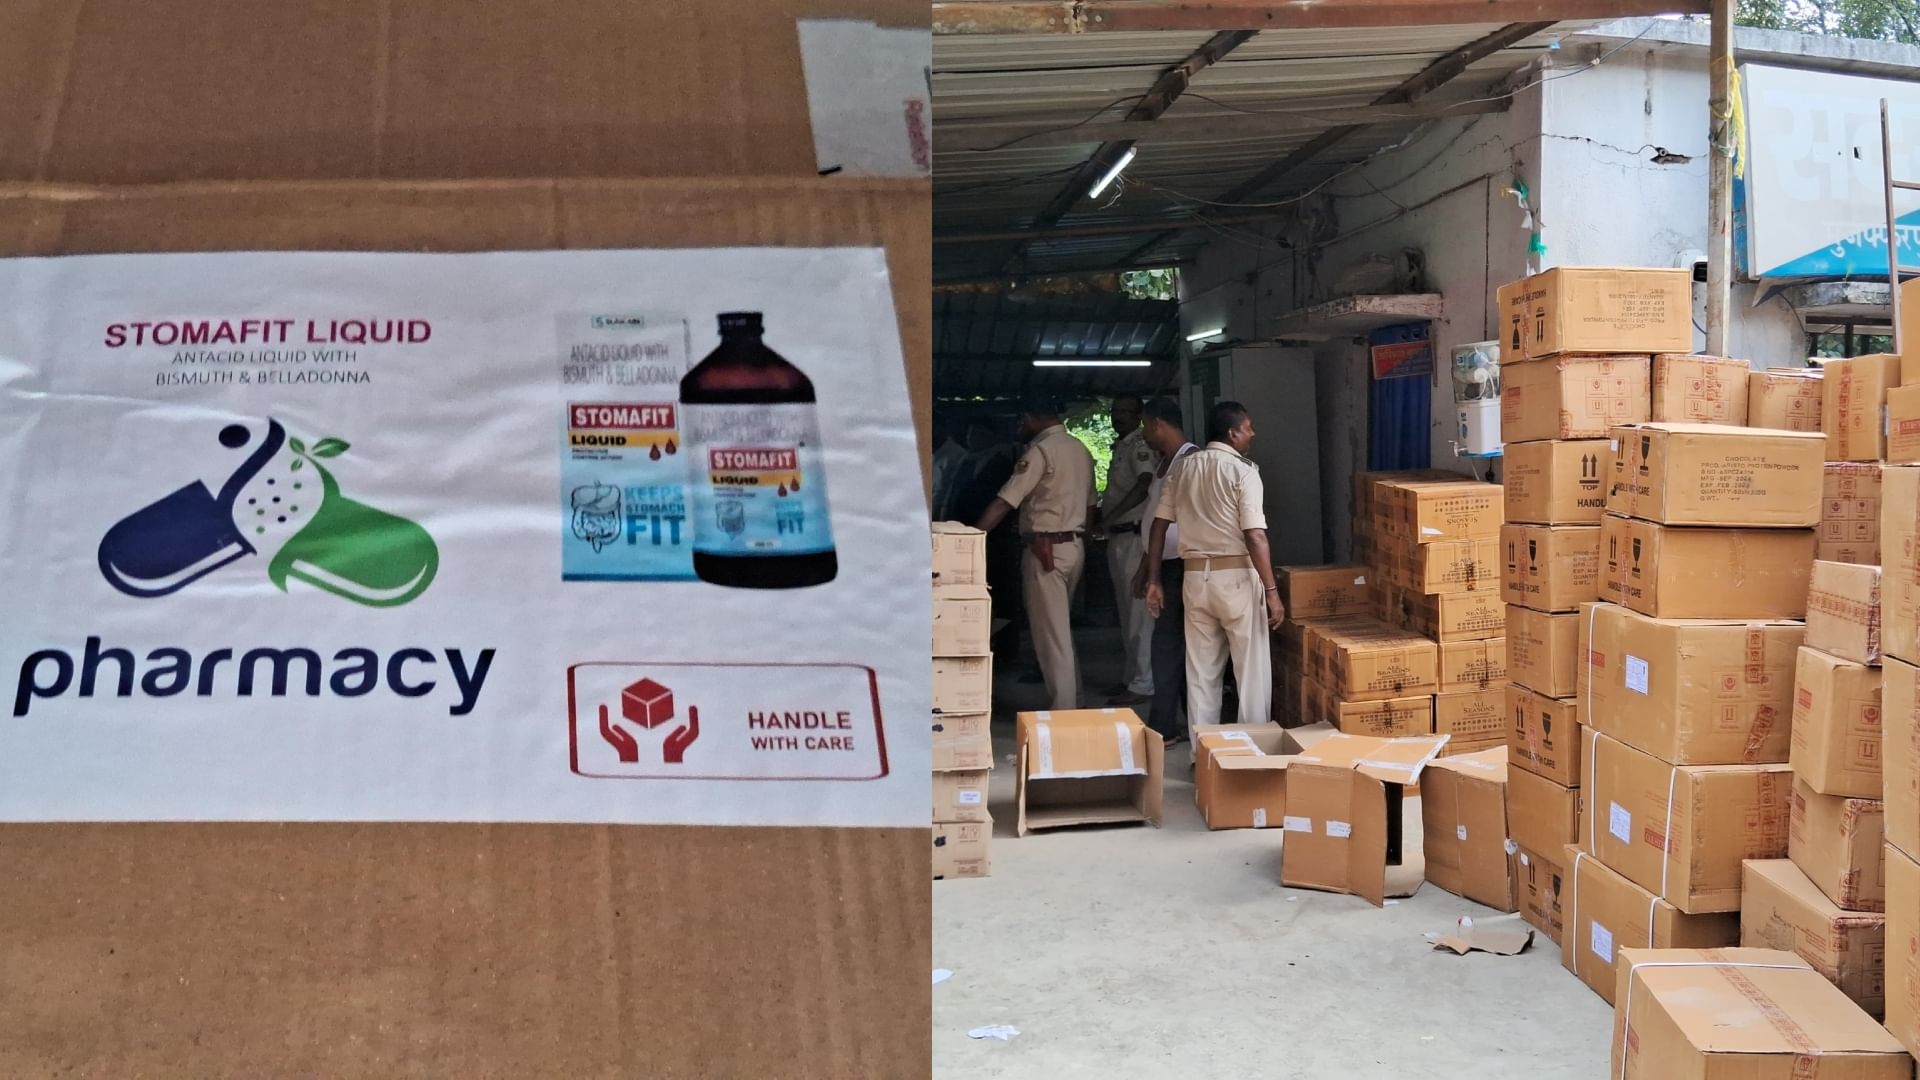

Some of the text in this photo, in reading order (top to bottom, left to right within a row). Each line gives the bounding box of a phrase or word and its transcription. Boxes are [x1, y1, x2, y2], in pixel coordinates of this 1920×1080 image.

[105, 319, 431, 348] STOMAFIT LIQUID
[171, 350, 357, 364] ANTACID LIQUID WITH
[156, 370, 370, 386] BISMUTH & BELLADONNA
[575, 408, 669, 426] STOMAFIT
[571, 435, 627, 446] LIQUID
[714, 452, 792, 468] STOMAFIT
[712, 475, 758, 485] LIQUID
[625, 503, 686, 514] STOMACH
[626, 515, 686, 545] FIT
[777, 518, 804, 535] FIT
[13, 636, 496, 717] pharmacy
[1463, 706, 1496, 714] SEASONS
[748, 712, 852, 730] HANDLE
[751, 736, 855, 751] WITH CARE
